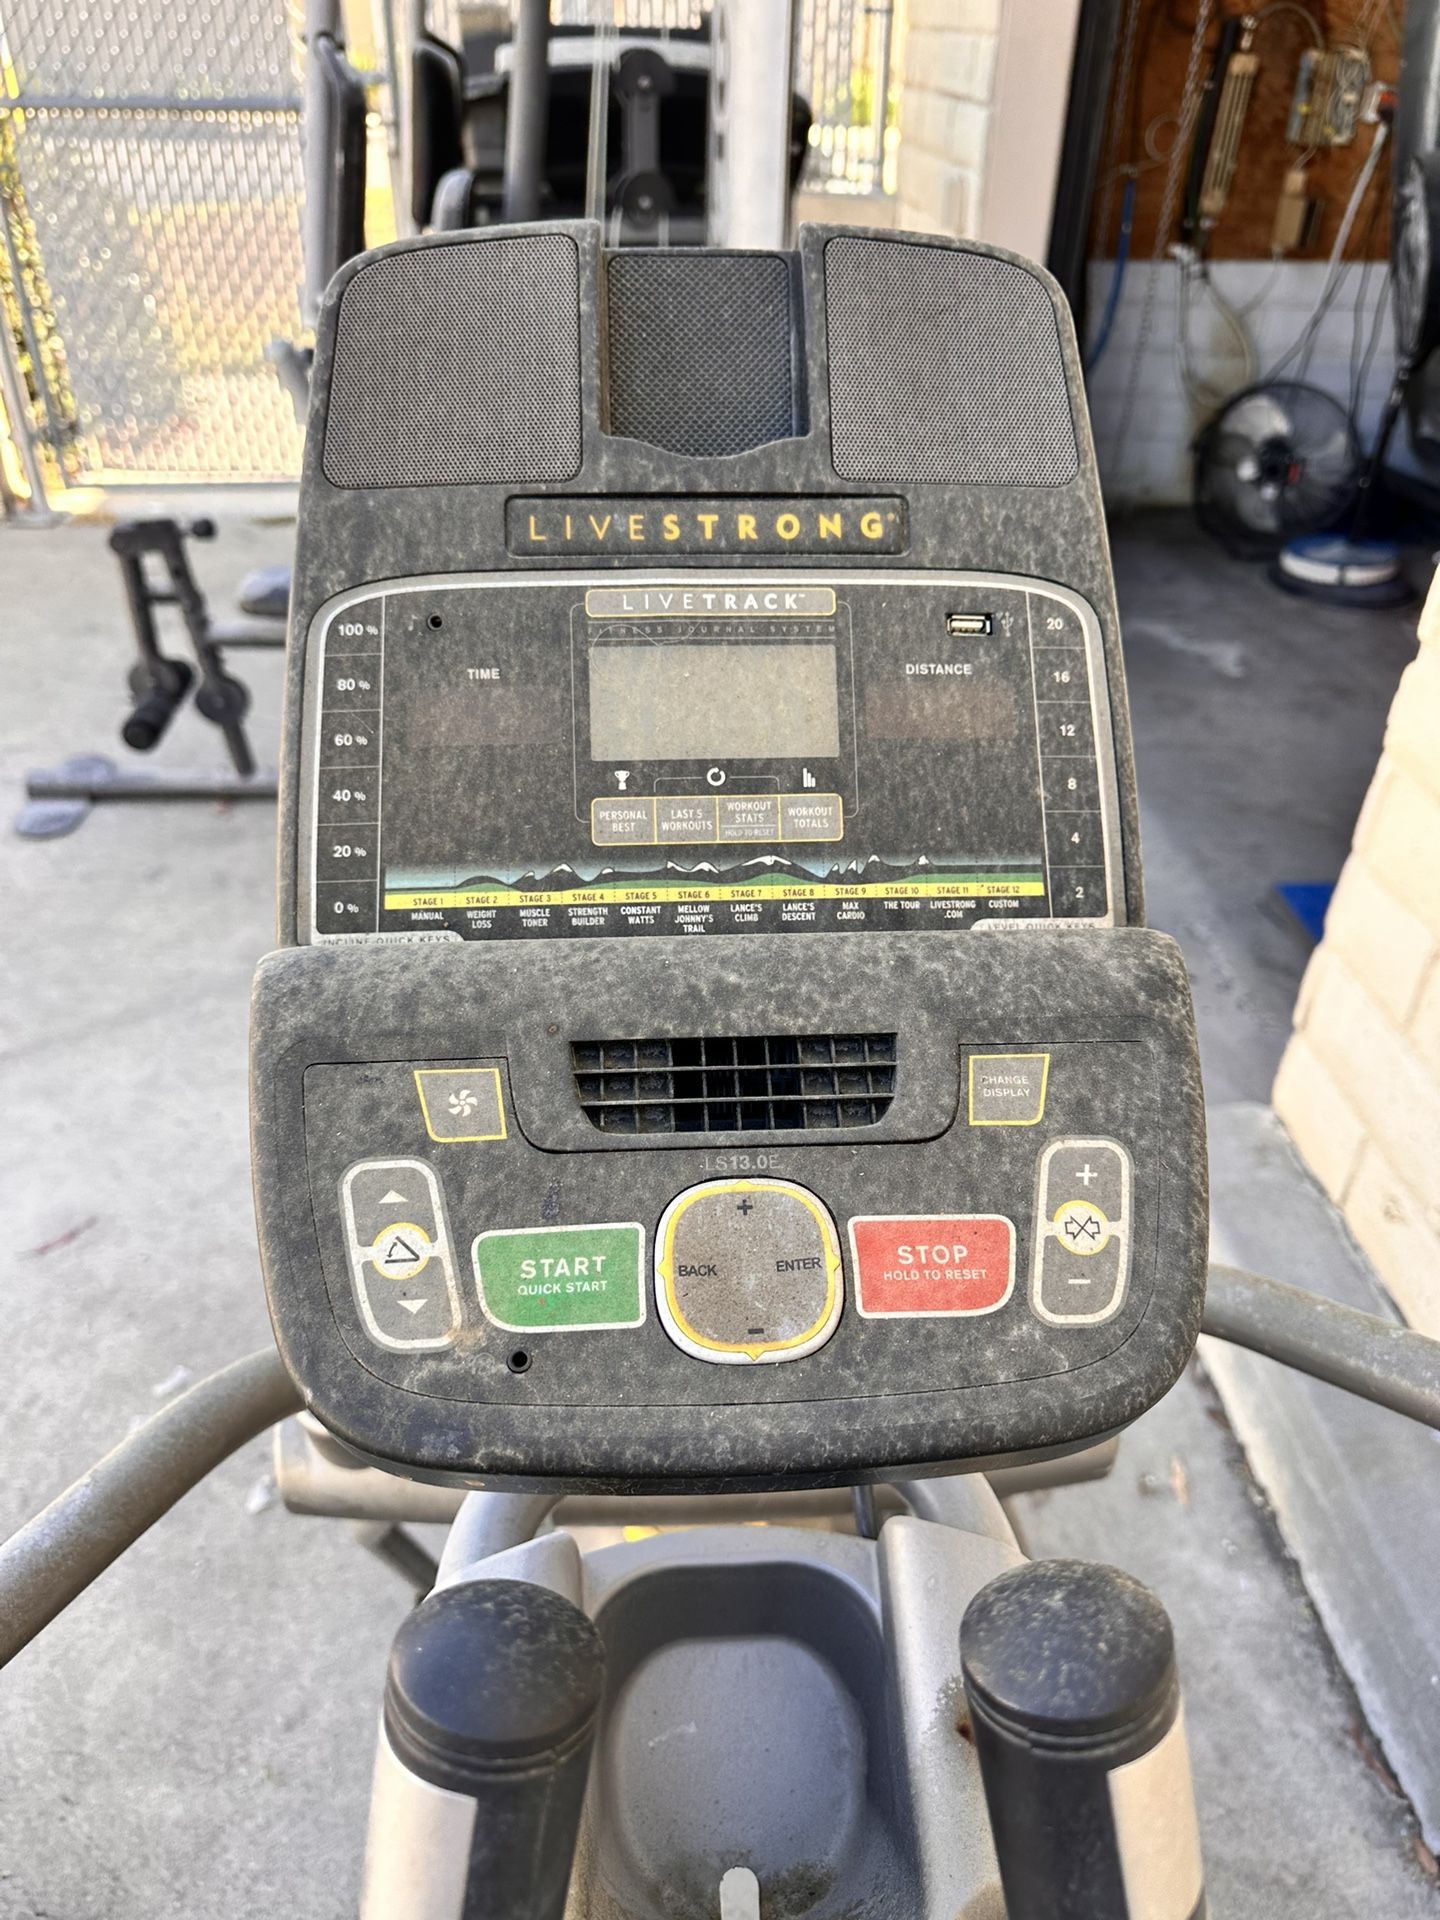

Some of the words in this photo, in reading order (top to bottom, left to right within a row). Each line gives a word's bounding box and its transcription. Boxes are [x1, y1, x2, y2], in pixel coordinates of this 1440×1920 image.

[769, 624, 836, 633] SYSTEM
[1046, 618, 1063, 630] 20
[338, 623, 364, 636] 100
[366, 625, 379, 636] %
[905, 663, 973, 675] DISTANCE
[467, 668, 500, 680] TIME
[1053, 671, 1070, 683] 16
[337, 678, 355, 691] 80
[359, 680, 371, 691] %
[1060, 724, 1075, 737] 12
[334, 734, 352, 746] 60
[356, 735, 368, 745] %
[1067, 777, 1077, 790] 8
[333, 790, 351, 802] 40
[354, 791, 366, 801] %
[726, 801, 772, 811] WORKOUT
[600, 810, 647, 821] PERSONAL
[671, 810, 694, 820] LAST
[696, 809, 702, 818] 5
[788, 807, 833, 817] WORKOUT
[735, 813, 764, 823] STATS
[612, 822, 636, 832] BEST
[661, 821, 713, 831] WORKOUTS
[793, 818, 829, 829] TOTALS
[1070, 832, 1080, 844] 4
[333, 845, 351, 858] 20
[355, 847, 367, 857] %
[731, 890, 754, 898] STAGE
[783, 889, 807, 897] STAGE
[835, 888, 859, 896] STAGE
[885, 887, 909, 895] STAGE
[937, 886, 960, 894] STAGE
[987, 886, 1010, 894] STAGE
[1075, 886, 1085, 898] 2
[519, 895, 543, 903] STAGE
[572, 893, 596, 901] STAGE
[625, 892, 649, 900] STAGE
[678, 891, 702, 899] STAGE
[413, 898, 437, 906] STAGE
[465, 896, 489, 904] STAGE
[492, 896, 498, 904] 2
[930, 900, 976, 909] LIVESTRONG
[988, 900, 1020, 909] CUSTOM
[334, 901, 344, 914] 0
[347, 903, 359, 914] %
[678, 905, 711, 914] MELLOW
[730, 904, 763, 912] LANCE'S
[782, 902, 815, 911] LANCE'S
[842, 902, 859, 910] MAX
[883, 901, 898, 910] THE
[900, 901, 921, 909] TOUR
[466, 910, 497, 919] WEIGHT
[519, 909, 551, 917] MUSCLE
[568, 907, 609, 916] STRENGTH
[620, 906, 662, 915] CONSTANT
[944, 910, 964, 918] .COM
[411, 912, 445, 920] MANUAL
[627, 916, 655, 924] WATTS
[675, 914, 714, 923] JOHNNY'S
[734, 913, 759, 922] CLIMB
[781, 912, 816, 921] DESCENT
[836, 911, 866, 920] CARDIO
[471, 920, 493, 928] LOSS
[522, 918, 549, 927] TONER
[571, 917, 605, 925] BUILDER
[682, 924, 706, 933] TRAIL
[982, 1075, 1029, 1085] CHANGE
[983, 1088, 1030, 1097] DISPLAY
[705, 1154, 780, 1171] LS13.0E
[897, 1245, 968, 1265] STOP
[520, 1255, 606, 1280] START
[776, 1257, 822, 1273] ENTER
[678, 1264, 718, 1277] BACK
[883, 1270, 918, 1281] HOLD
[923, 1270, 941, 1280] TO
[944, 1269, 987, 1280] RESET
[517, 1281, 562, 1296] QUICK
[566, 1280, 608, 1293] START
